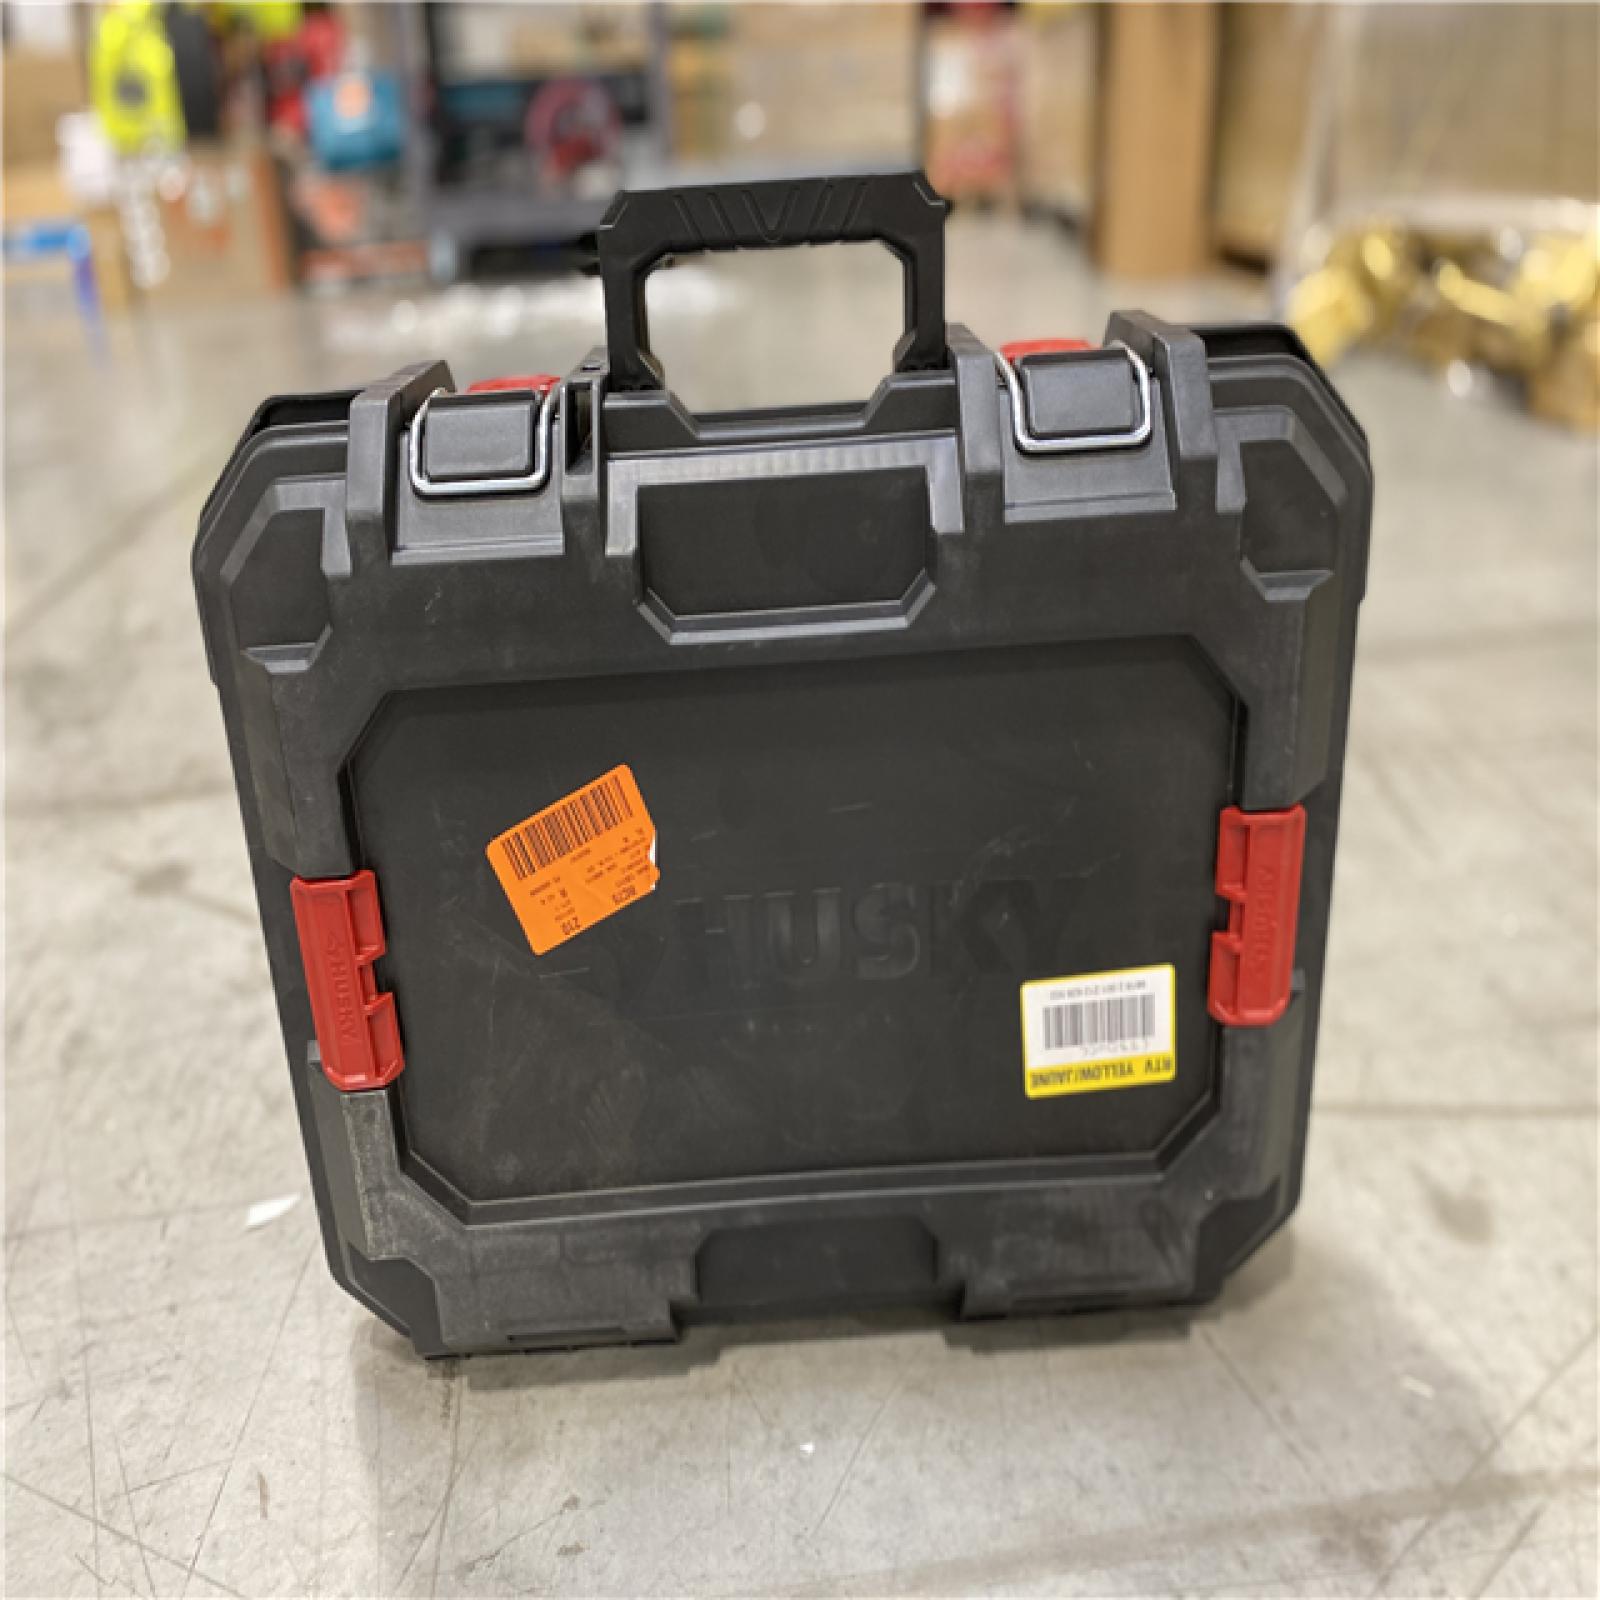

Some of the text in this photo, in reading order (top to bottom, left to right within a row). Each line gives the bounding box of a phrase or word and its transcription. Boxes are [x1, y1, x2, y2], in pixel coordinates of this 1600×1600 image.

[672, 873, 1090, 988] HUSKY
[329, 960, 358, 1041] HUSKY
[1144, 1056, 1172, 1075] RTV
